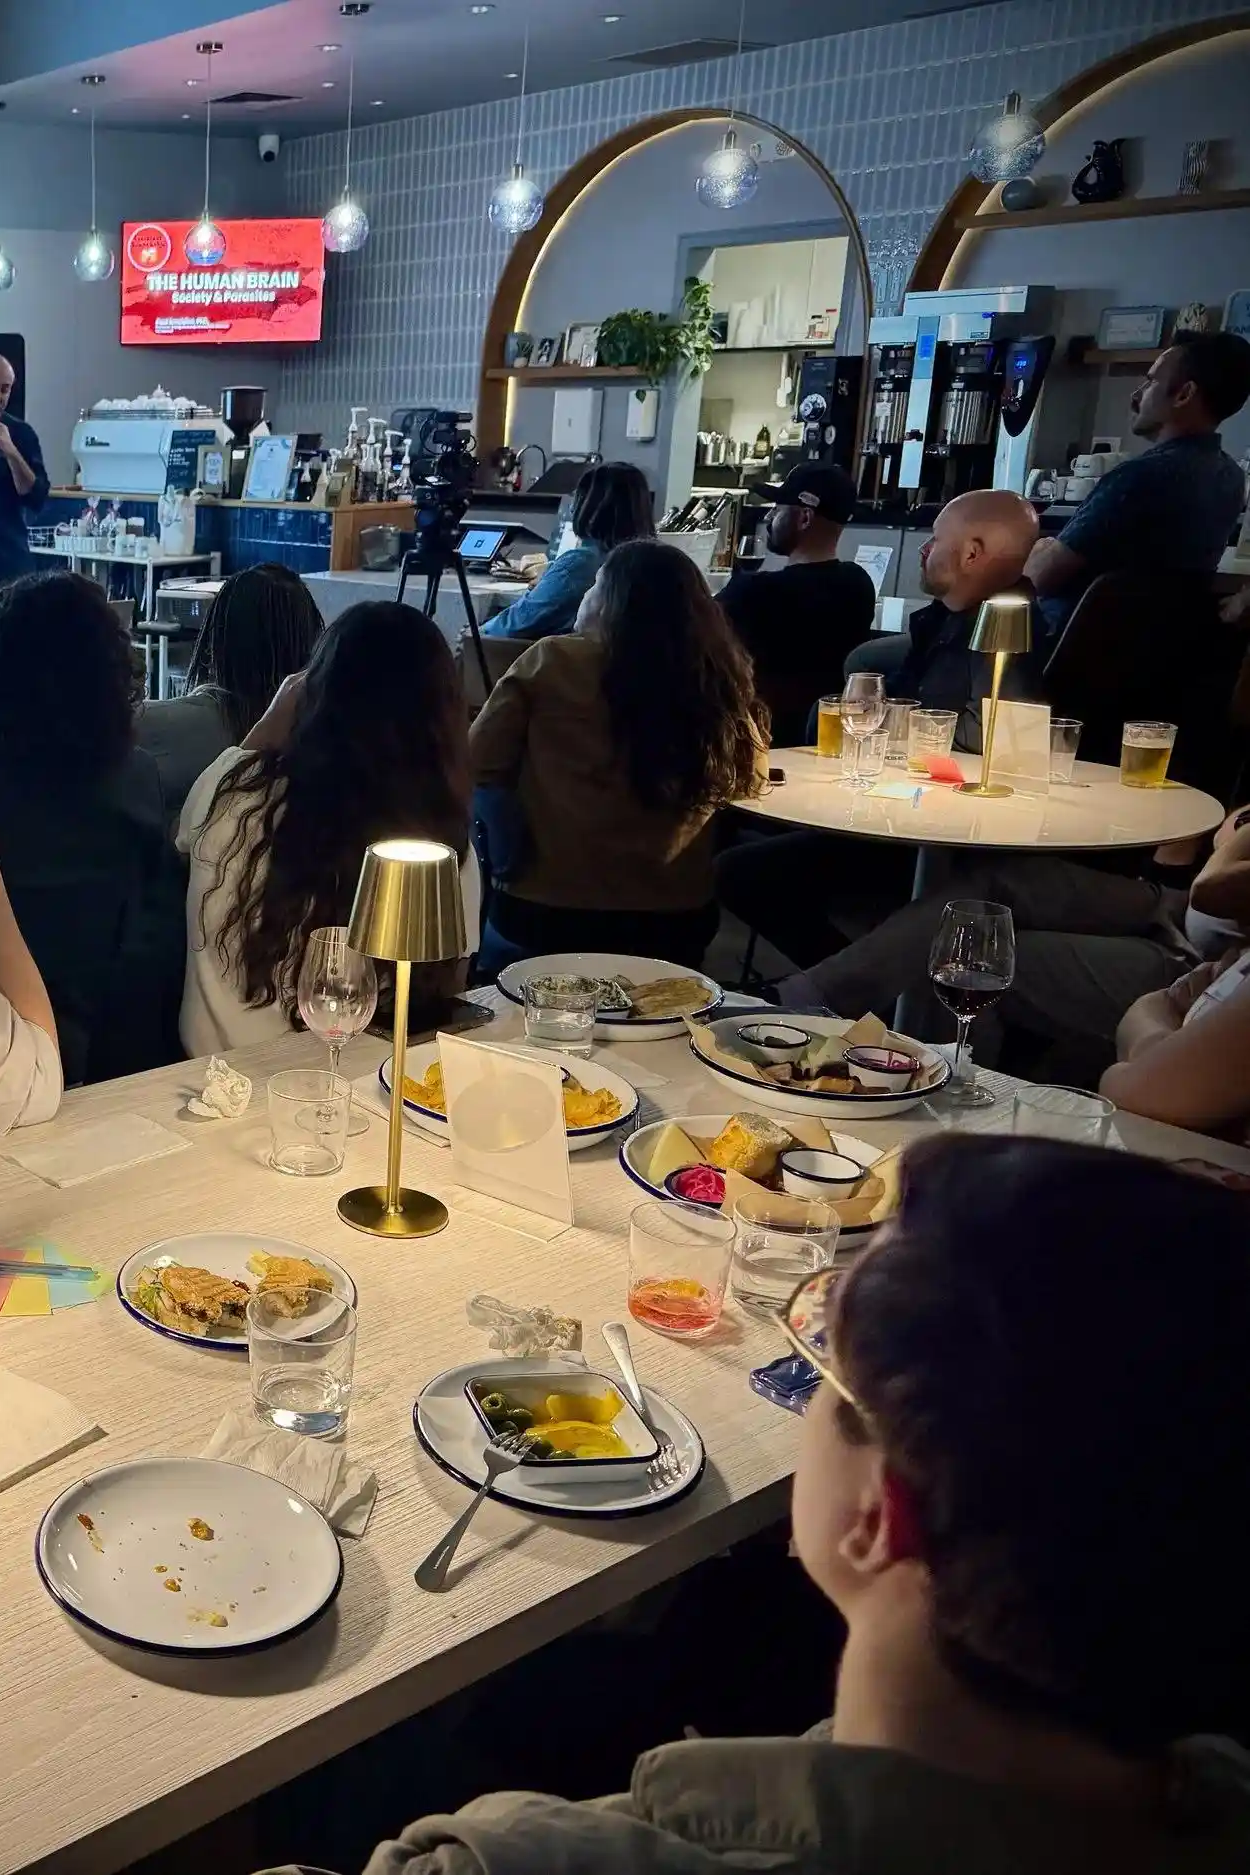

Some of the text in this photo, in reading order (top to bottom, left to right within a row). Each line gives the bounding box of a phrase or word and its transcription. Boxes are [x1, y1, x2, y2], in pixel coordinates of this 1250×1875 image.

[147, 271, 300, 290] THE HUMAN BRAIN
[172, 290, 212, 306] Society
